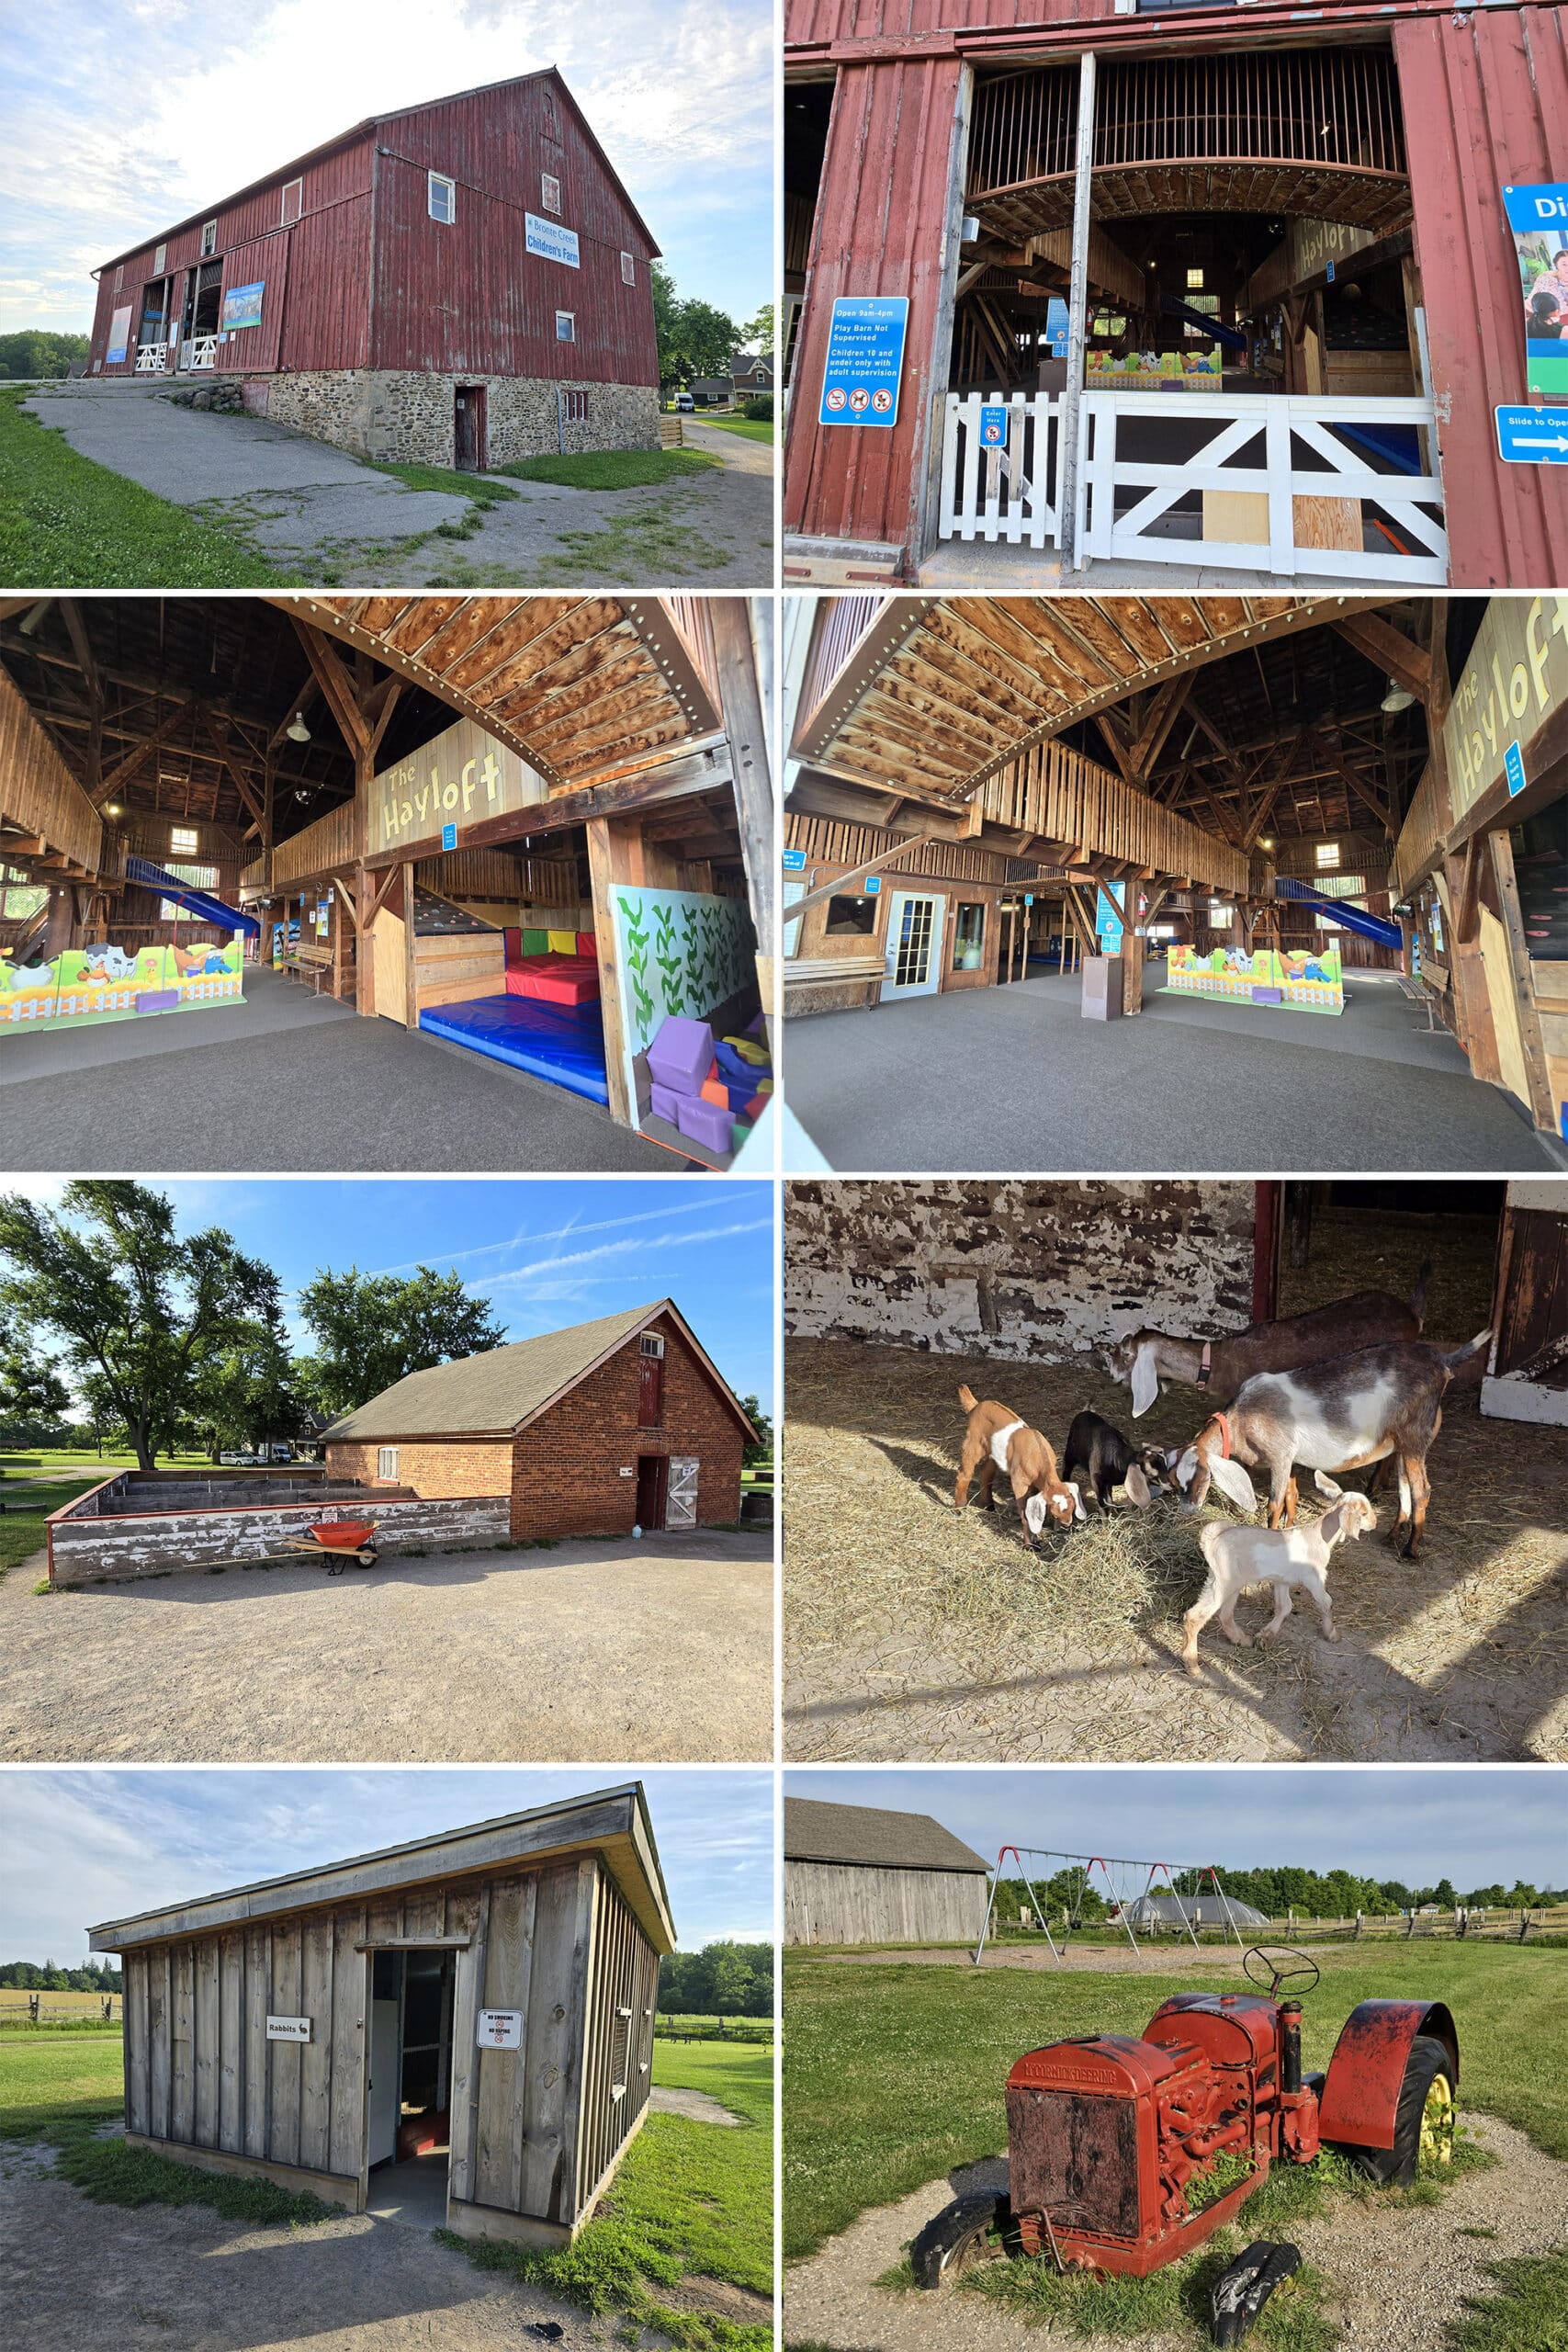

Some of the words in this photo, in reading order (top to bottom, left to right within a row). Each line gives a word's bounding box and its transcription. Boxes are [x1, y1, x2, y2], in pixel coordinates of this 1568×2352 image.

[1534, 197, 1568, 218] Di
[534, 220, 557, 238] Bronte
[558, 230, 577, 245] Creek
[527, 234, 561, 257] Children's
[562, 247, 579, 264] Farm
[836, 310, 856, 318] Open
[859, 310, 893, 318] 9am-4pm
[834, 324, 851, 333] Play
[833, 334, 876, 342] Supervised
[854, 359, 872, 368] only
[851, 369, 897, 378] supervision
[1508, 417, 1532, 425] Slide
[1456, 670, 1479, 725] The
[389, 765, 416, 792] The
[383, 752, 501, 841] Hayloft
[269, 2024, 297, 2033] Rabbits
